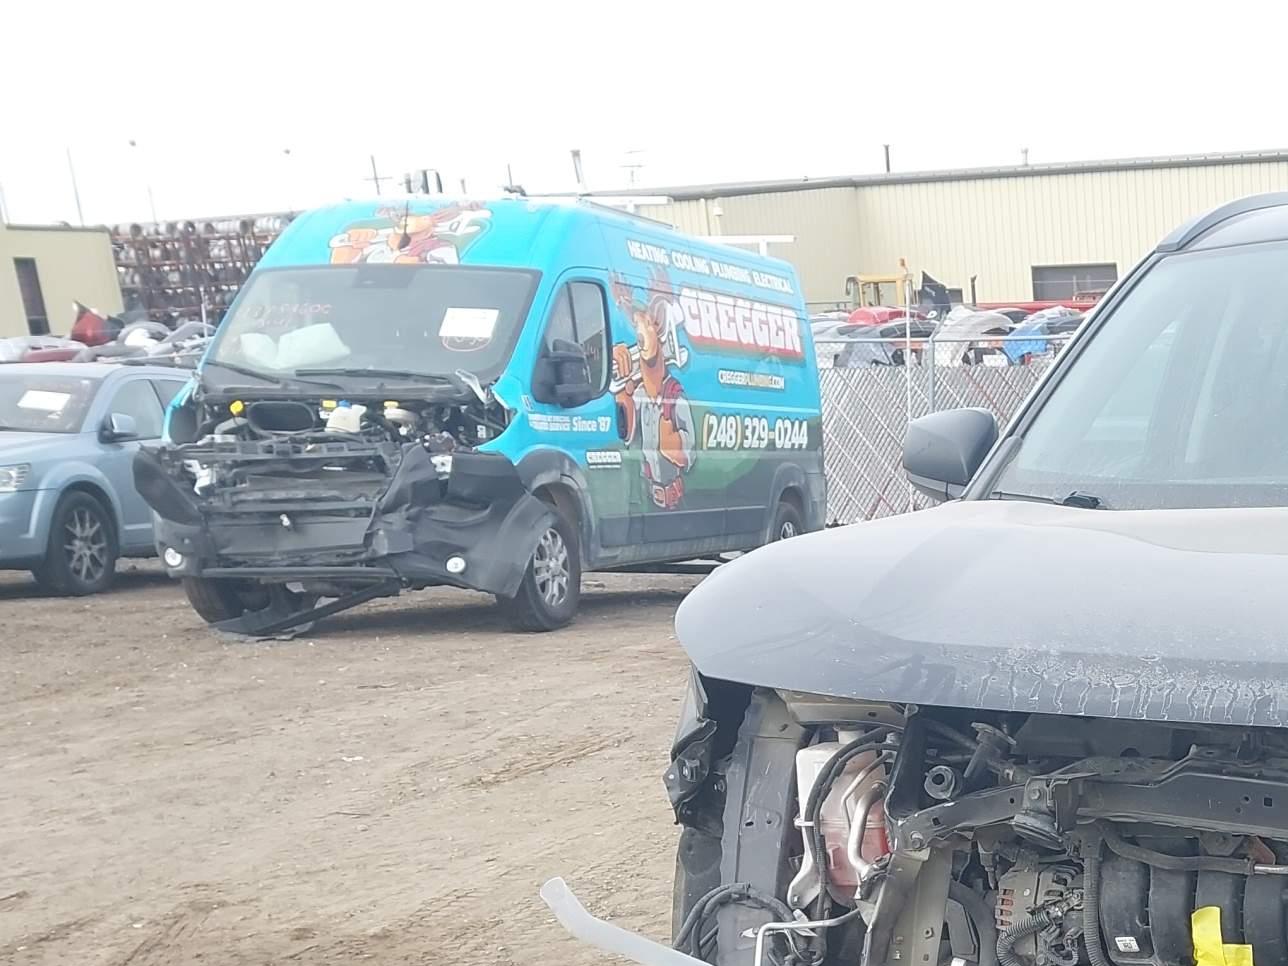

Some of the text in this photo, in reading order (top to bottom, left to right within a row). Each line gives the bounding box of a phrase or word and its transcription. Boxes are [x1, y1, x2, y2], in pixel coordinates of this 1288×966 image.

[627, 239, 670, 266] HEATING
[671, 250, 710, 276] COOLING
[752, 269, 795, 294] ELECTRICAL
[679, 287, 802, 354] CREGGER
[572, 415, 598, 432] Since
[597, 416, 612, 432] '87
[703, 413, 808, 451] (248) 329-0244
